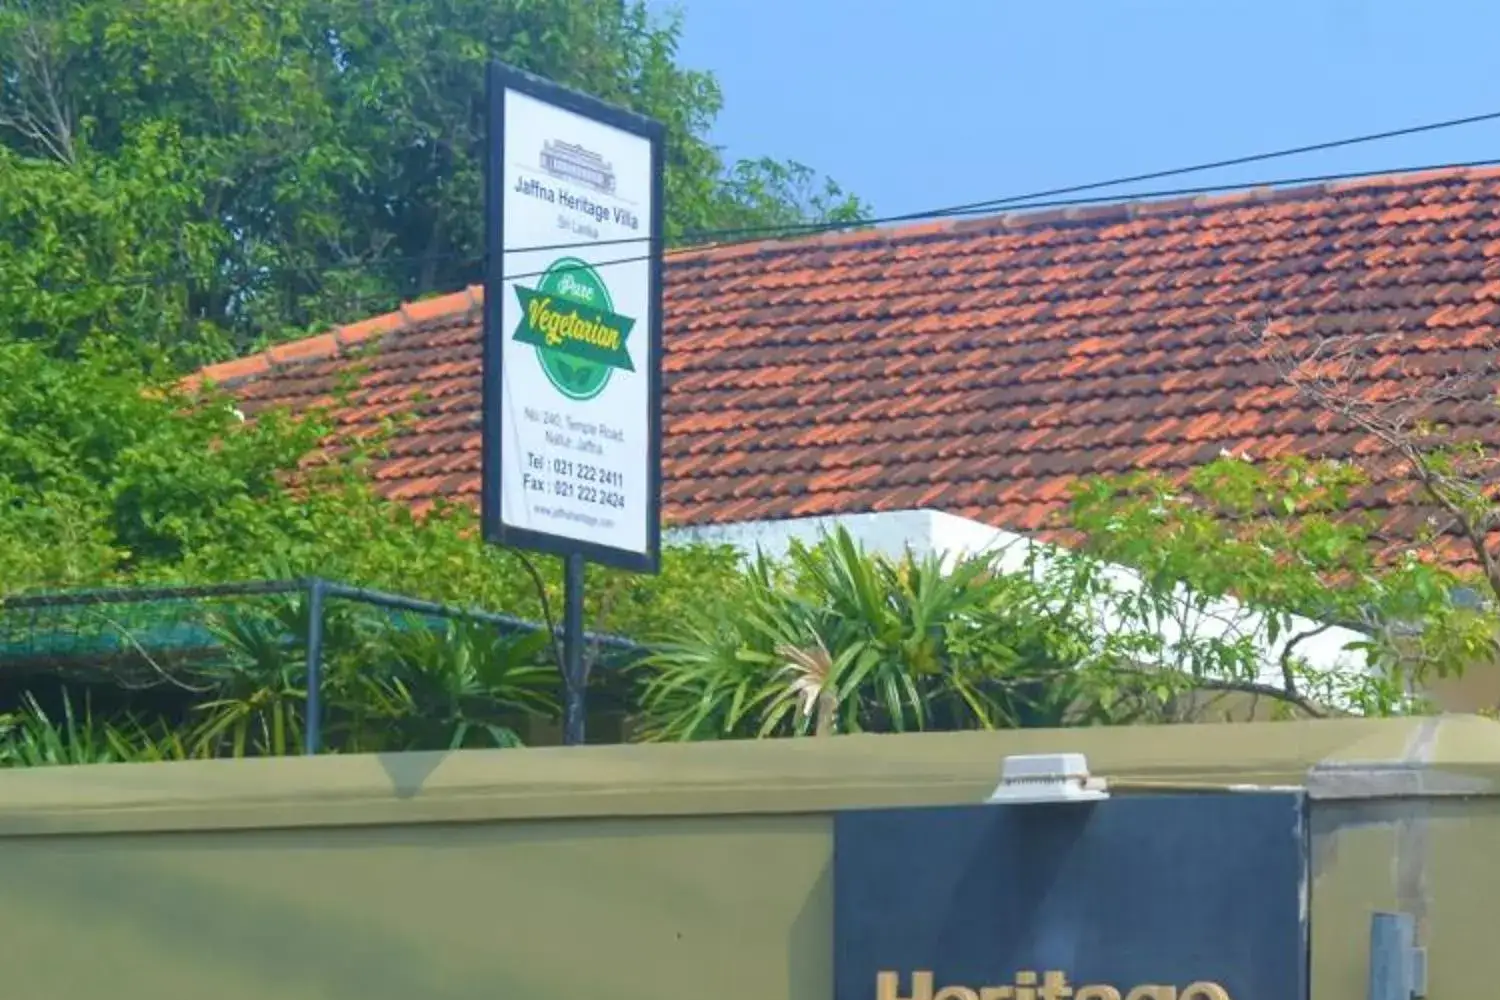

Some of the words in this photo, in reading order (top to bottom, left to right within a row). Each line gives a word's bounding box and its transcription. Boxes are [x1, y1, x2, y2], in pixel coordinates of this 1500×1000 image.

[515, 176, 555, 203] Jaffna
[558, 188, 609, 223] Heritage
[613, 206, 638, 230] Villa
[529, 296, 620, 351] Vegetarian
[523, 473, 545, 491] Fax
[555, 480, 574, 496] 021
[577, 485, 597, 503] 222
[599, 489, 625, 509] 2424
[528, 452, 544, 470] Tel
[553, 458, 573, 476] 021
[577, 463, 596, 481] 222
[599, 468, 624, 489] 2411
